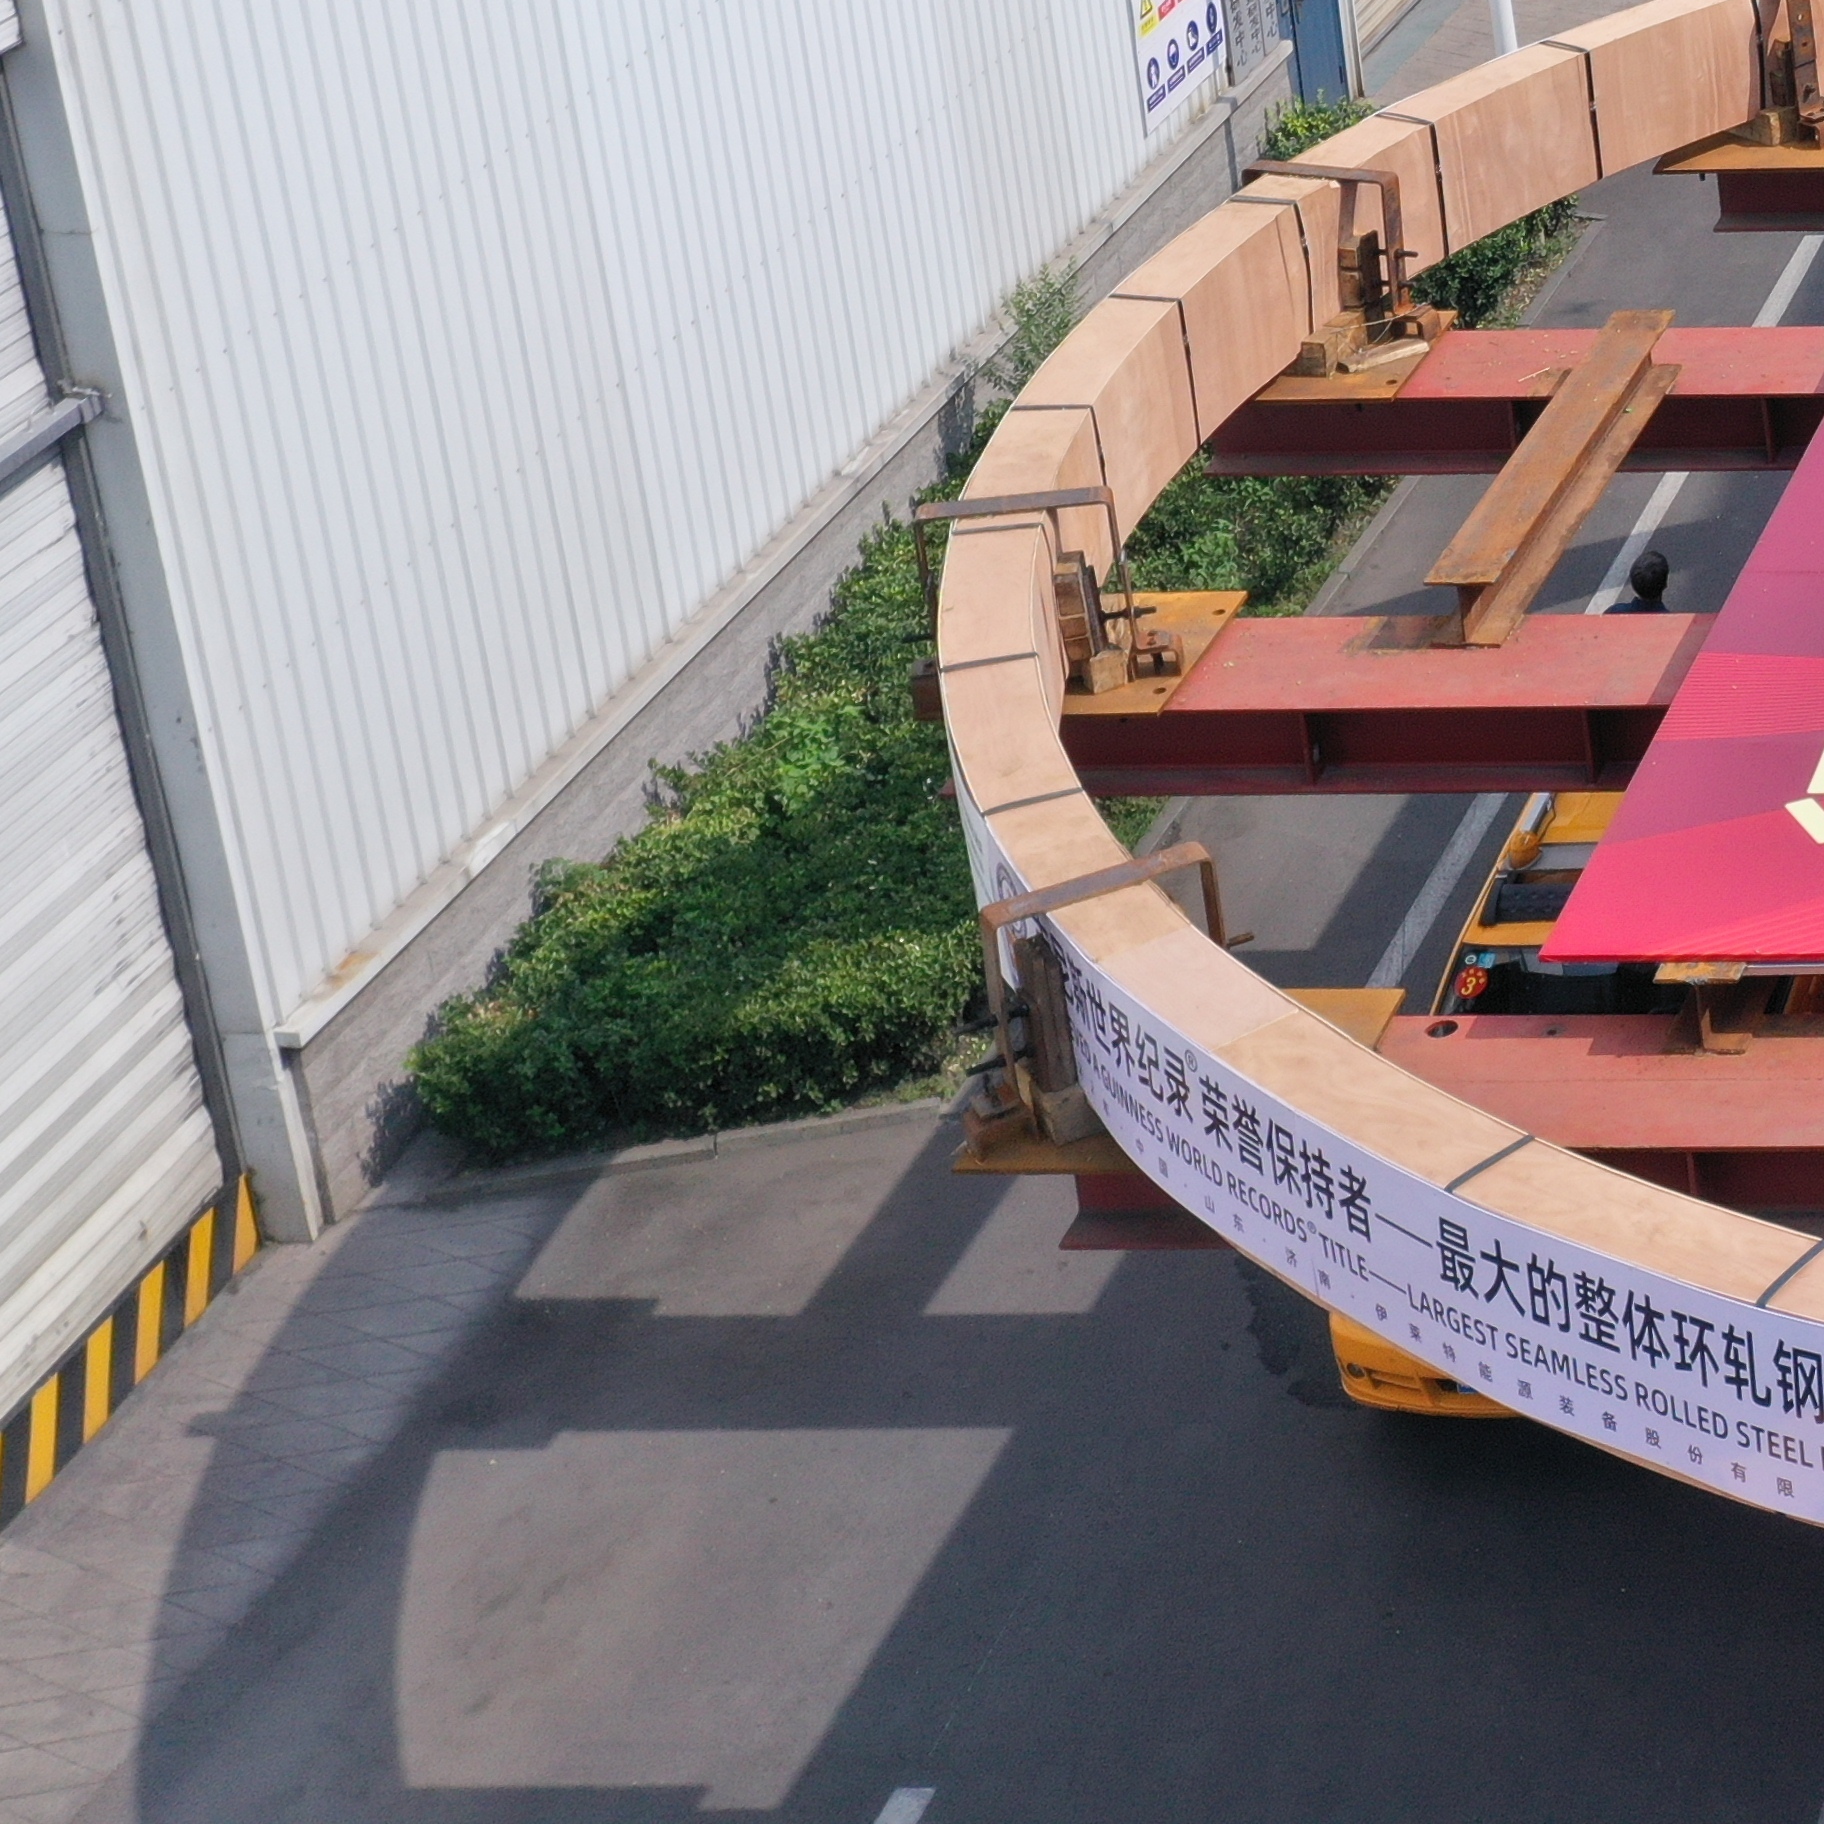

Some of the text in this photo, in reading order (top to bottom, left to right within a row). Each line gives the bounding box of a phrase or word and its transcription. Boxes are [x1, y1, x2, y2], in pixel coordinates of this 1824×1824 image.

[1101, 1064, 1164, 1144] GUINNESS
[1166, 1127, 1223, 1188] WORLD
[1505, 1332, 1630, 1404] SEAMLESS
[1635, 1380, 1729, 1442] ROLLED
[1736, 1421, 1814, 1469] STEEL
